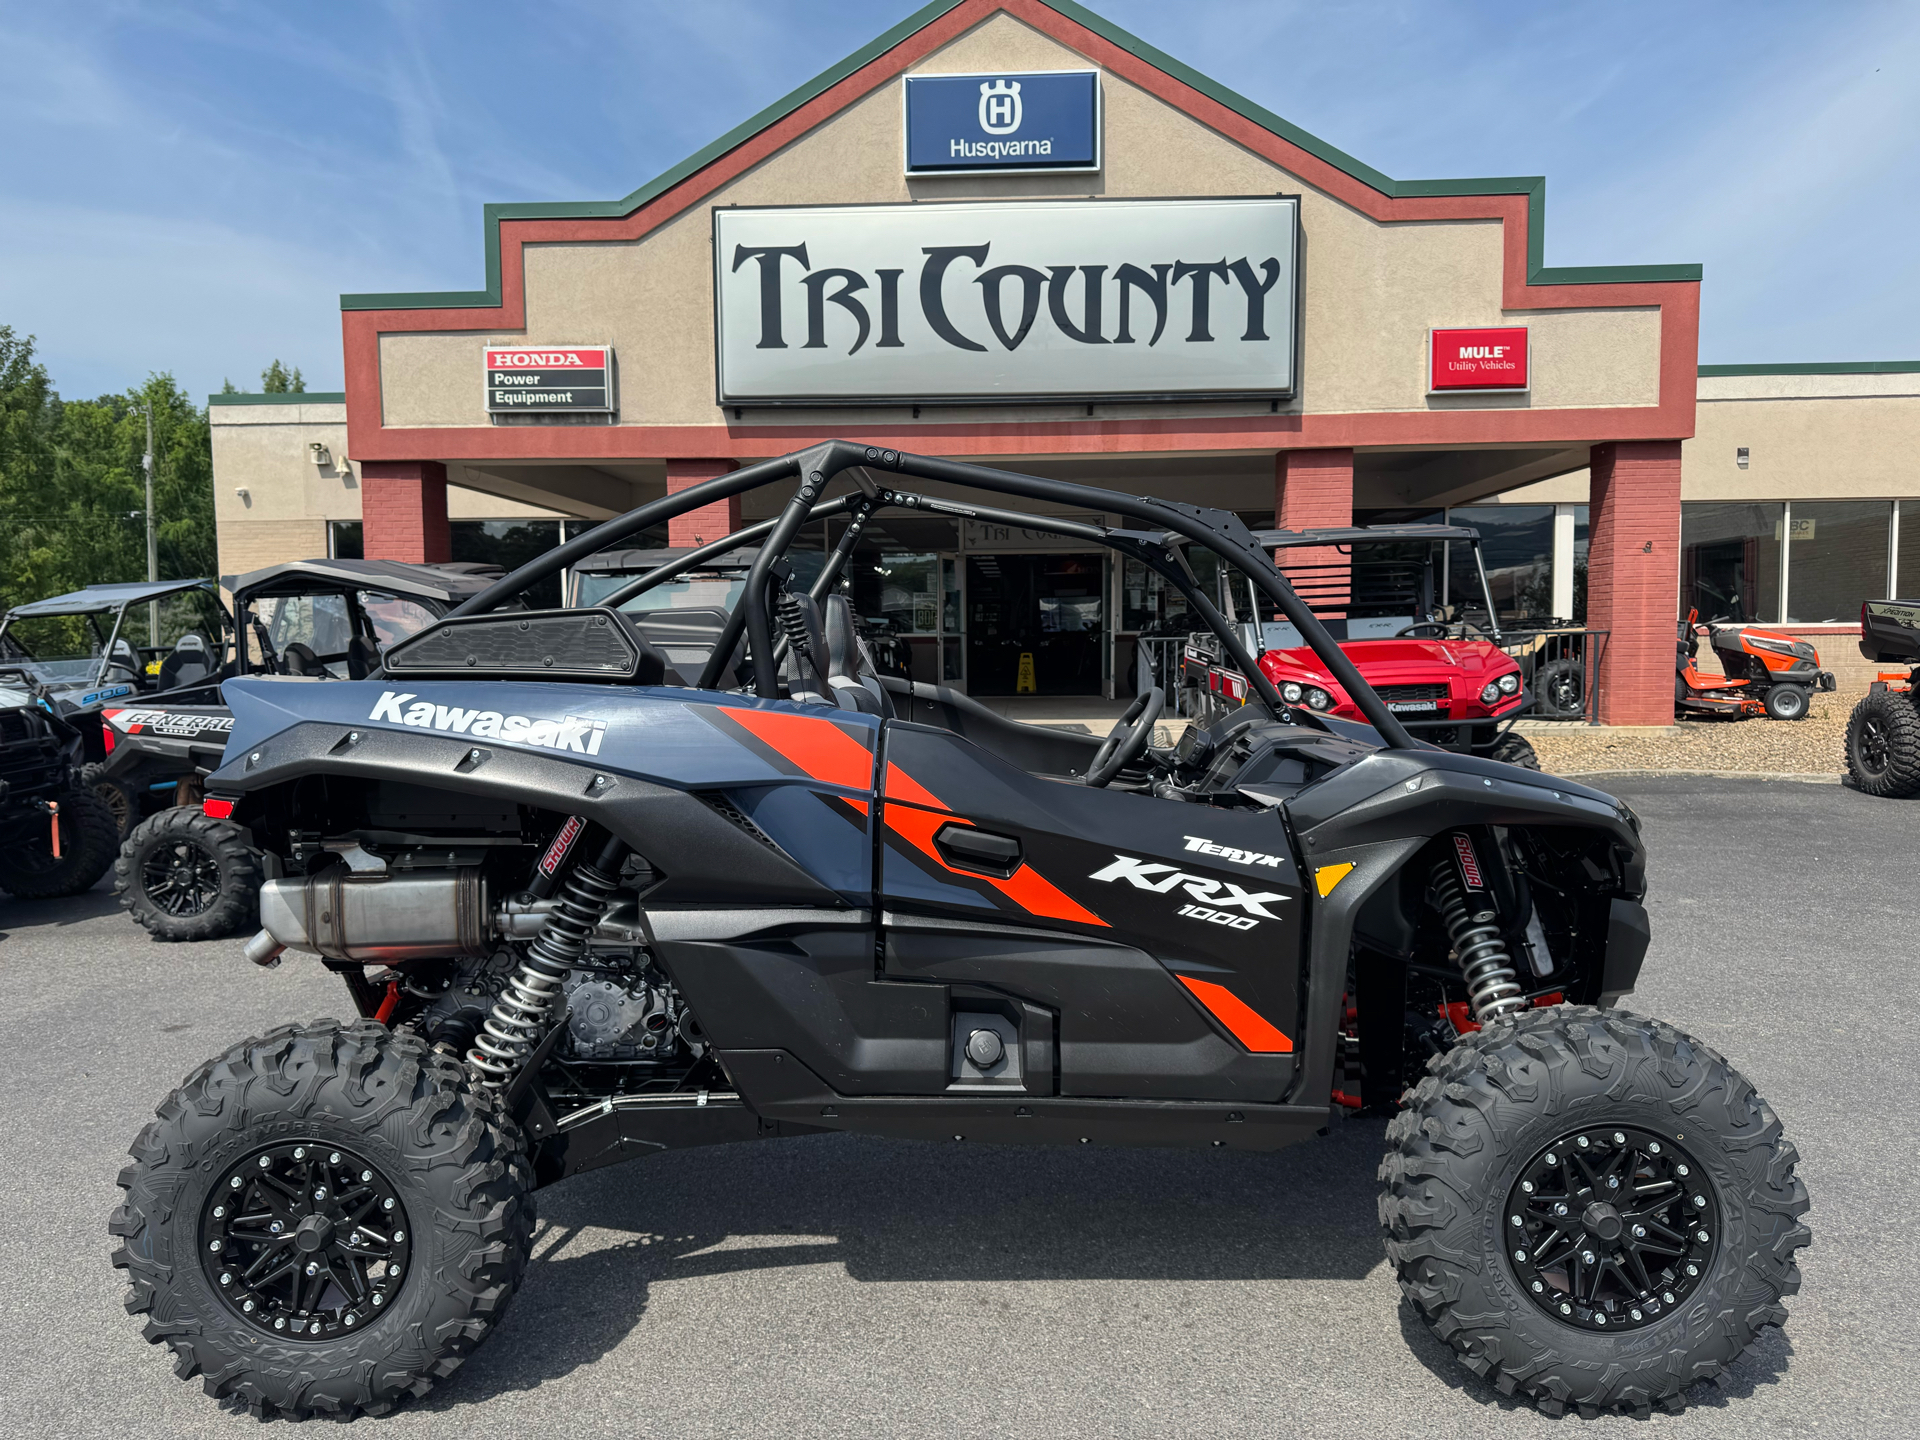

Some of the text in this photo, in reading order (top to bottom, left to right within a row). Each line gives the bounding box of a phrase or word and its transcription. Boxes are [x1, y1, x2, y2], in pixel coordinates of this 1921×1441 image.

[989, 97, 1012, 124] H
[950, 139, 1052, 160] Husqvarna
[731, 240, 1281, 356] TRI COUNTY
[494, 353, 584, 366] HONDA
[1448, 360, 1516, 372] Utility Vehicles
[494, 373, 541, 385] Power
[495, 391, 573, 405] Equipment
[1880, 606, 1916, 618] XPEDITION
[82, 684, 130, 705] 900
[1387, 701, 1437, 712] Kawasaki
[125, 713, 236, 732] GENERAL
[368, 691, 608, 756] Kawasaki
[543, 816, 581, 875] SHOWA
[1453, 836, 1483, 888] SHOWA
[1088, 854, 1293, 921] KRX
[1177, 903, 1260, 931] 1000
[1483, 1185, 1519, 1313] CARNIVORE
